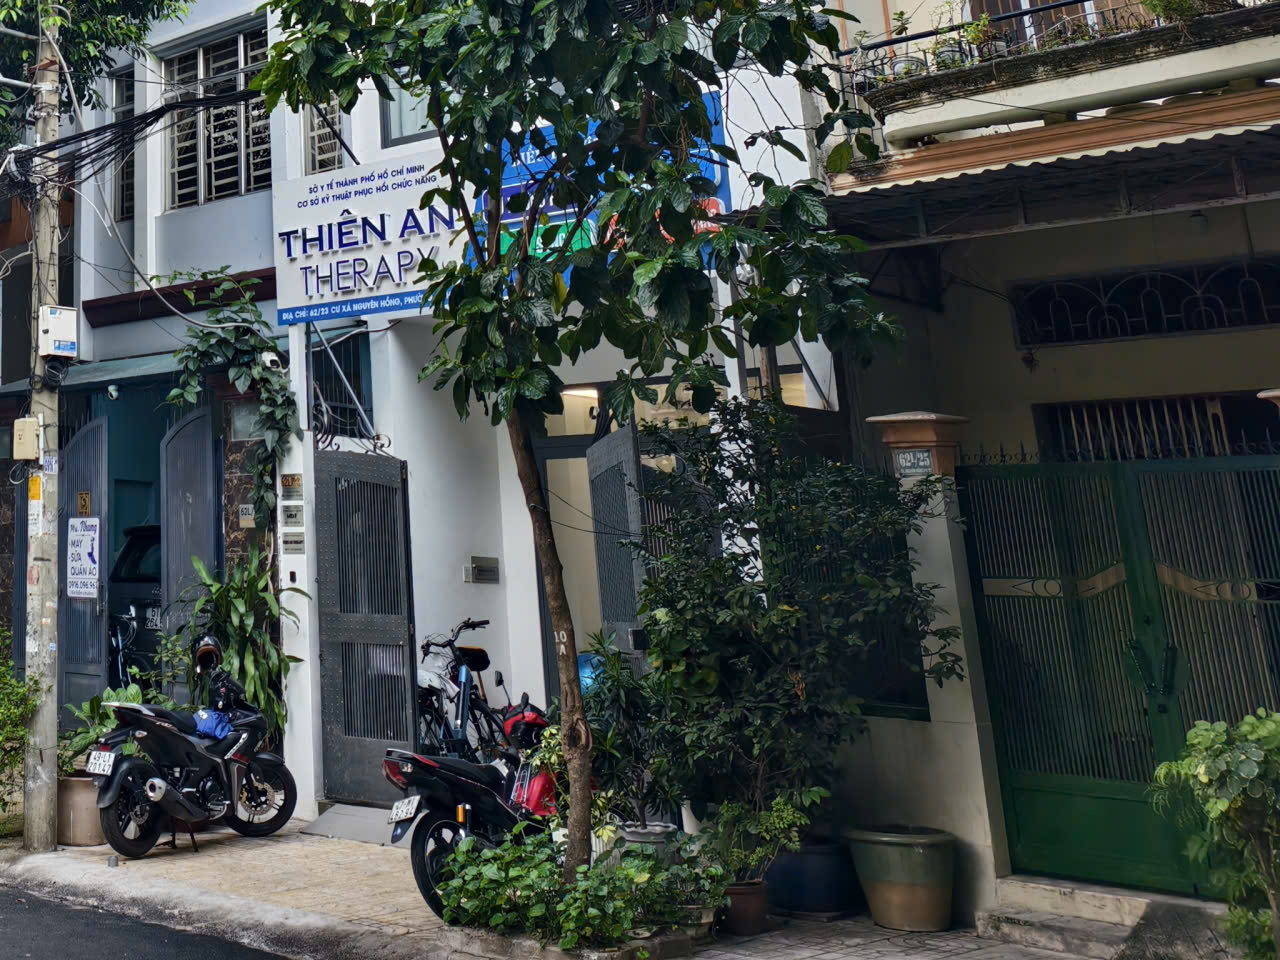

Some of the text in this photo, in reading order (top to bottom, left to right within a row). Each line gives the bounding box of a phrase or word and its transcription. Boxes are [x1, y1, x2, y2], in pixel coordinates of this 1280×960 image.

[297, 200, 308, 209] CƠ
[310, 195, 319, 206] SỞ
[331, 190, 352, 203] THUẬT
[354, 187, 374, 199] PHỤC
[375, 182, 389, 193] HỒI
[391, 178, 413, 190] CHỨC
[308, 183, 319, 195] SỞ
[326, 178, 334, 191] TẾ
[335, 178, 359, 190] THÀNH
[360, 172, 376, 184] PHỐ
[391, 166, 404, 178] CHÍ
[406, 164, 425, 174] MINH
[277, 204, 456, 259] THIÊN AN
[300, 246, 435, 297] THERAPY
[331, 304, 341, 314] CƯ
[342, 302, 352, 312] XÁ
[353, 299, 379, 312] NGUYÊN
